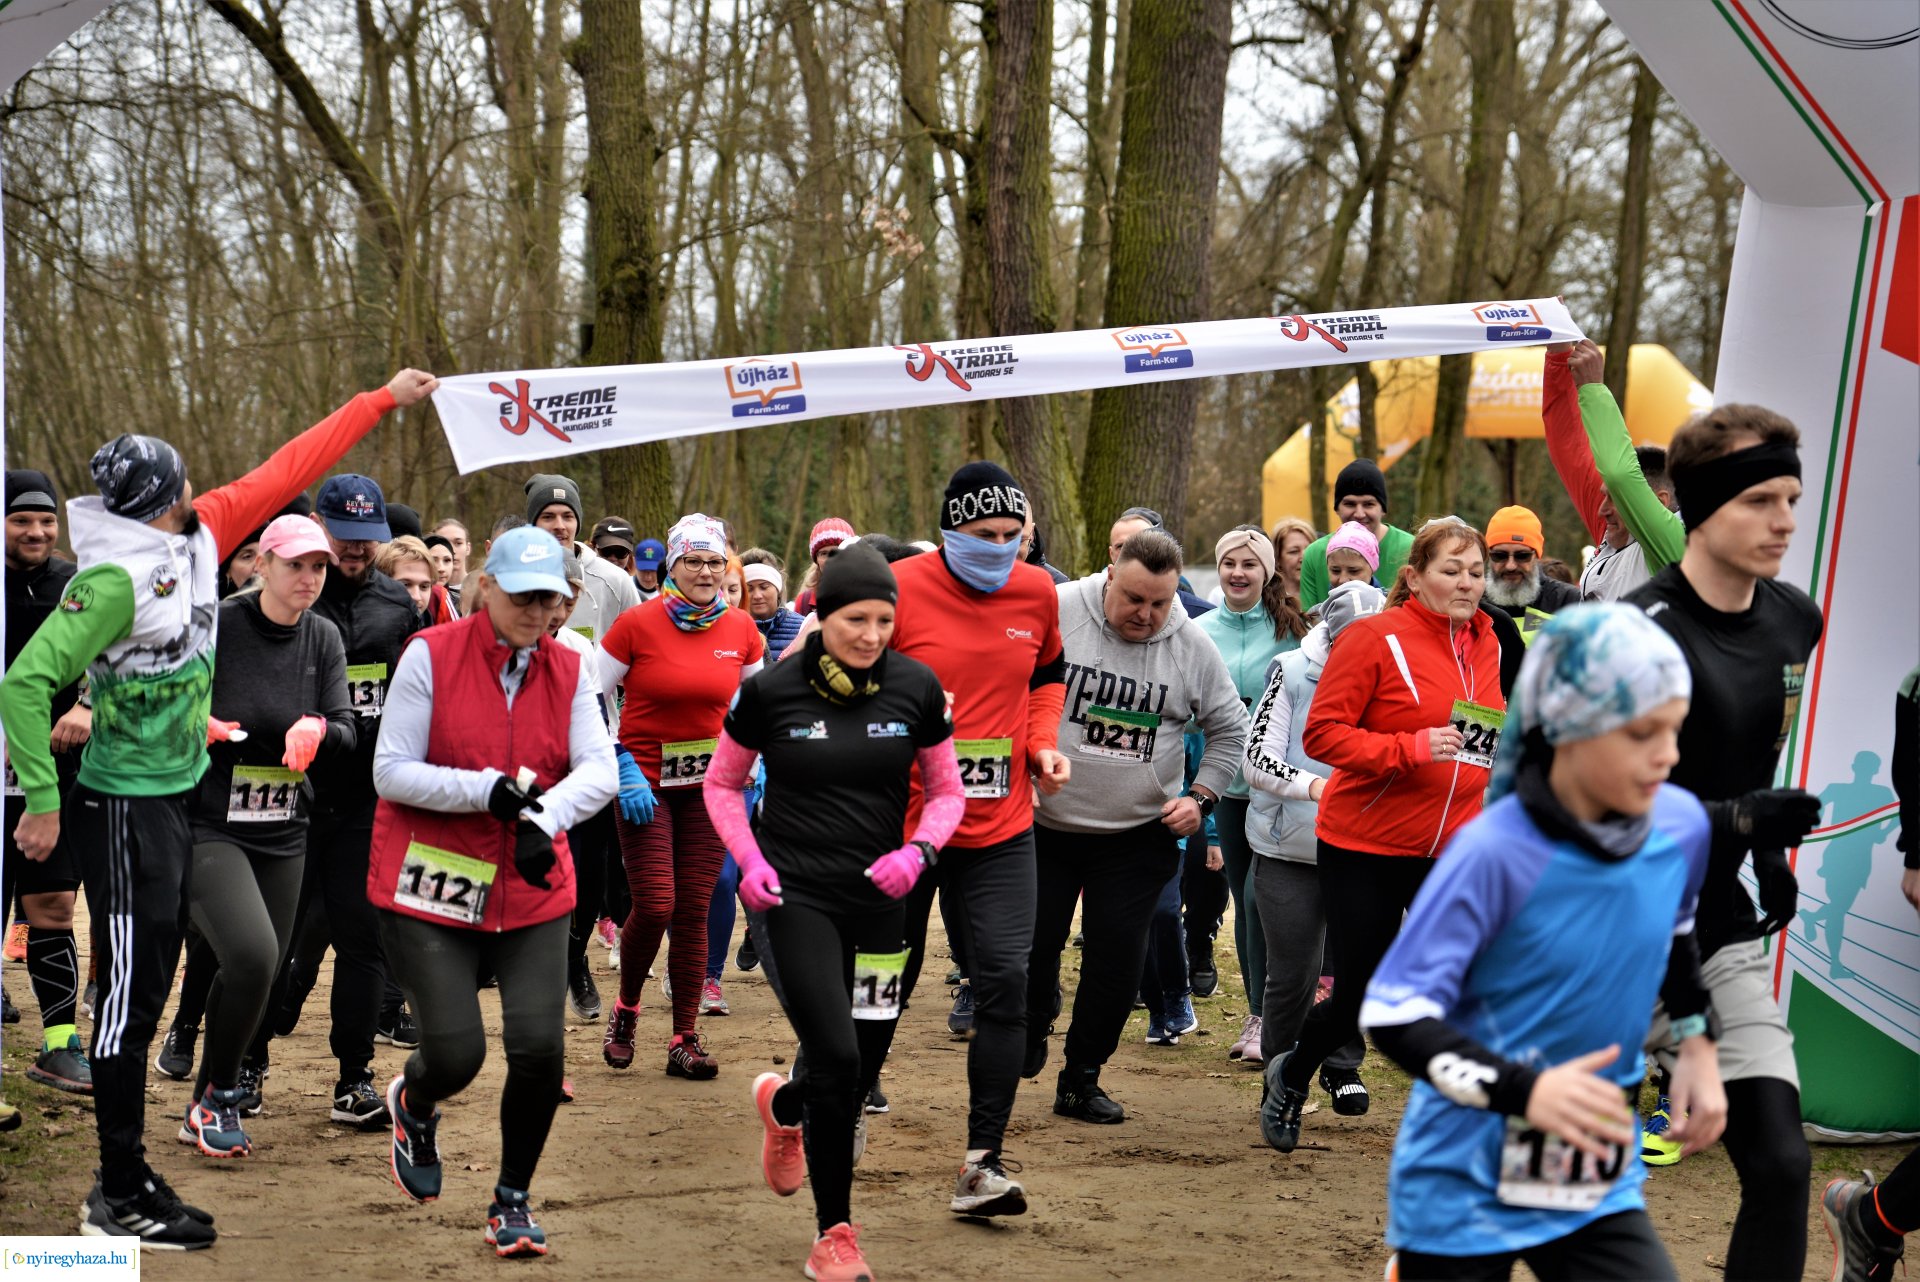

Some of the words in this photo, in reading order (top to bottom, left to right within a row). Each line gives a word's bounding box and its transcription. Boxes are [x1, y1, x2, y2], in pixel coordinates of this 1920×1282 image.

[1326, 322, 1387, 334] TRAIL
[1501, 328, 1538, 337] Farm-Ker
[954, 352, 1019, 369] TRAIL
[1140, 356, 1178, 366] Farm-Ker
[965, 368, 1001, 380] HUNGARY
[1003, 366, 1014, 375] SE
[549, 405, 617, 424] TRAIL
[748, 403, 790, 414] Farm-Ker
[563, 421, 599, 432] HUNGARY
[602, 418, 612, 427] SE
[949, 486, 1026, 526] BOGNE
[1087, 721, 1142, 750] 021
[1453, 720, 1497, 755] 124
[666, 753, 712, 777] 133
[236, 783, 289, 808] 114
[408, 865, 472, 907] 112
[860, 974, 897, 1005] 14
[1336, 1084, 1367, 1098] PUMA
